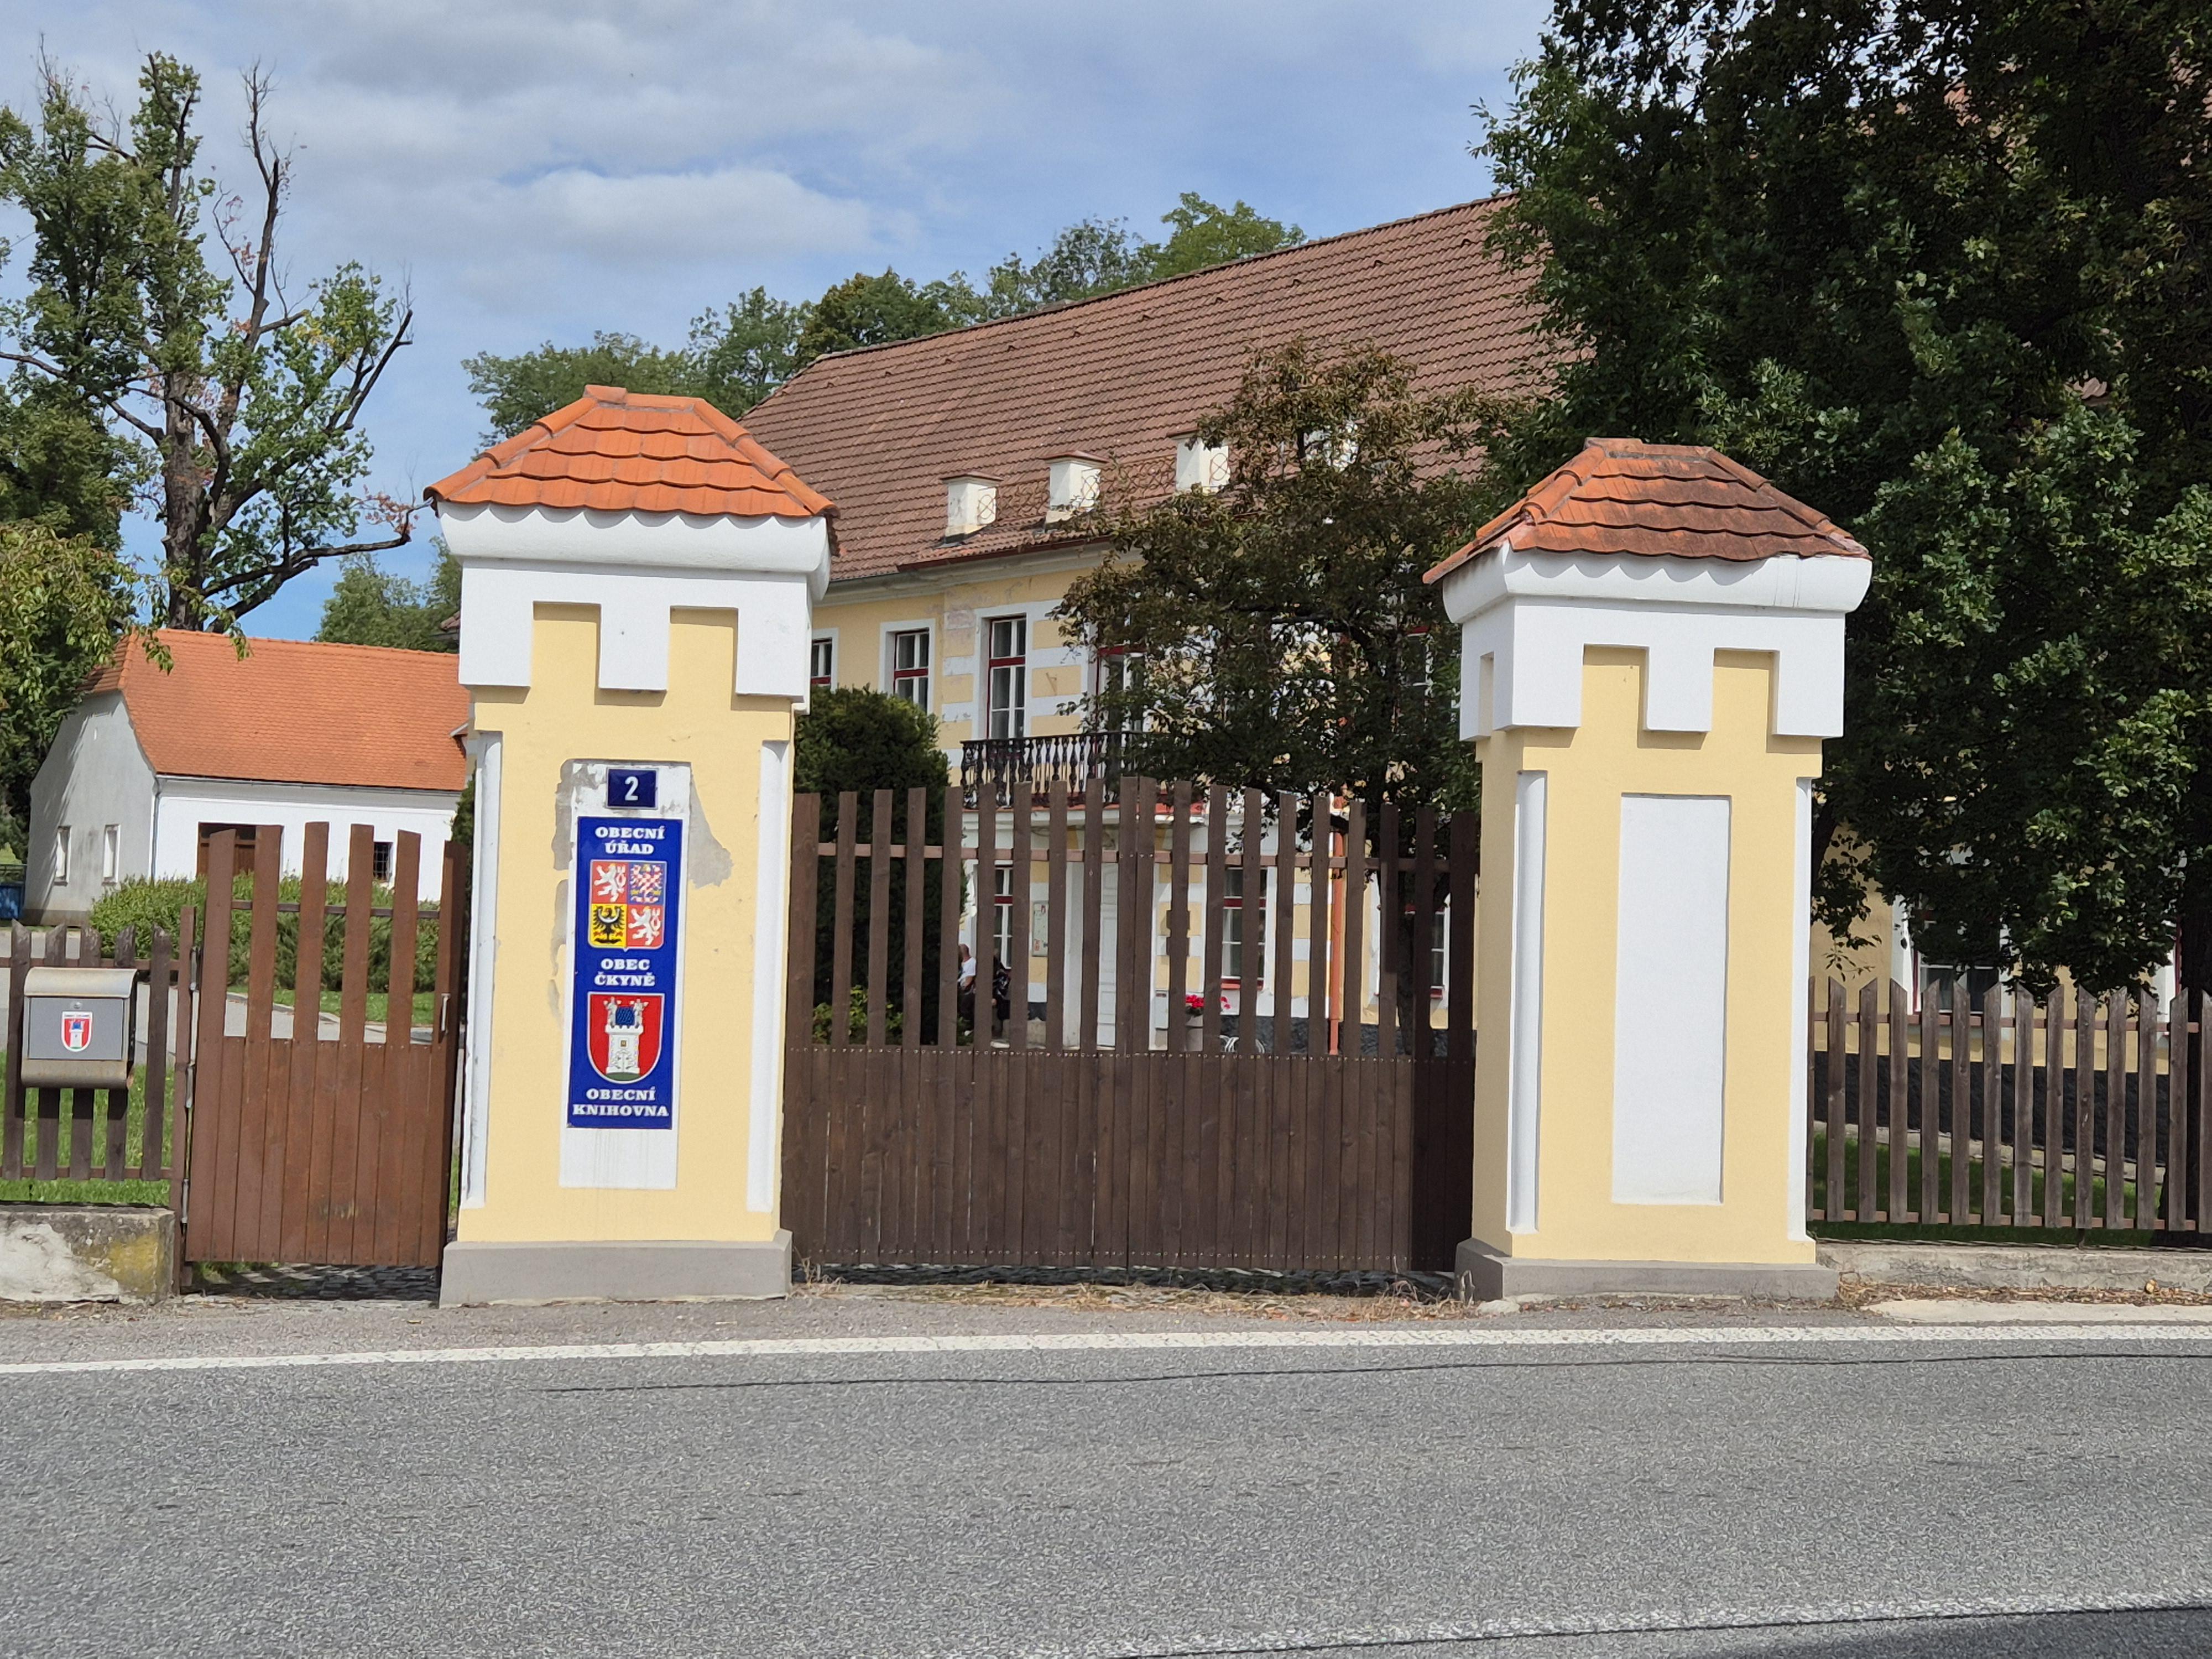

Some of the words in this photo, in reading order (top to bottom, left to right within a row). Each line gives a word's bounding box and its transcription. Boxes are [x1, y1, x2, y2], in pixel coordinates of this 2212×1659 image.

[625, 776, 638, 801] 2
[595, 826, 665, 839] OBECNÍ
[604, 840, 654, 854] ÚŘAD
[601, 958, 650, 971] OBEC
[594, 971, 656, 987] ČKYNĚ
[586, 1087, 656, 1100] OBECNÍ
[572, 1104, 669, 1117] KNIHOVNA
